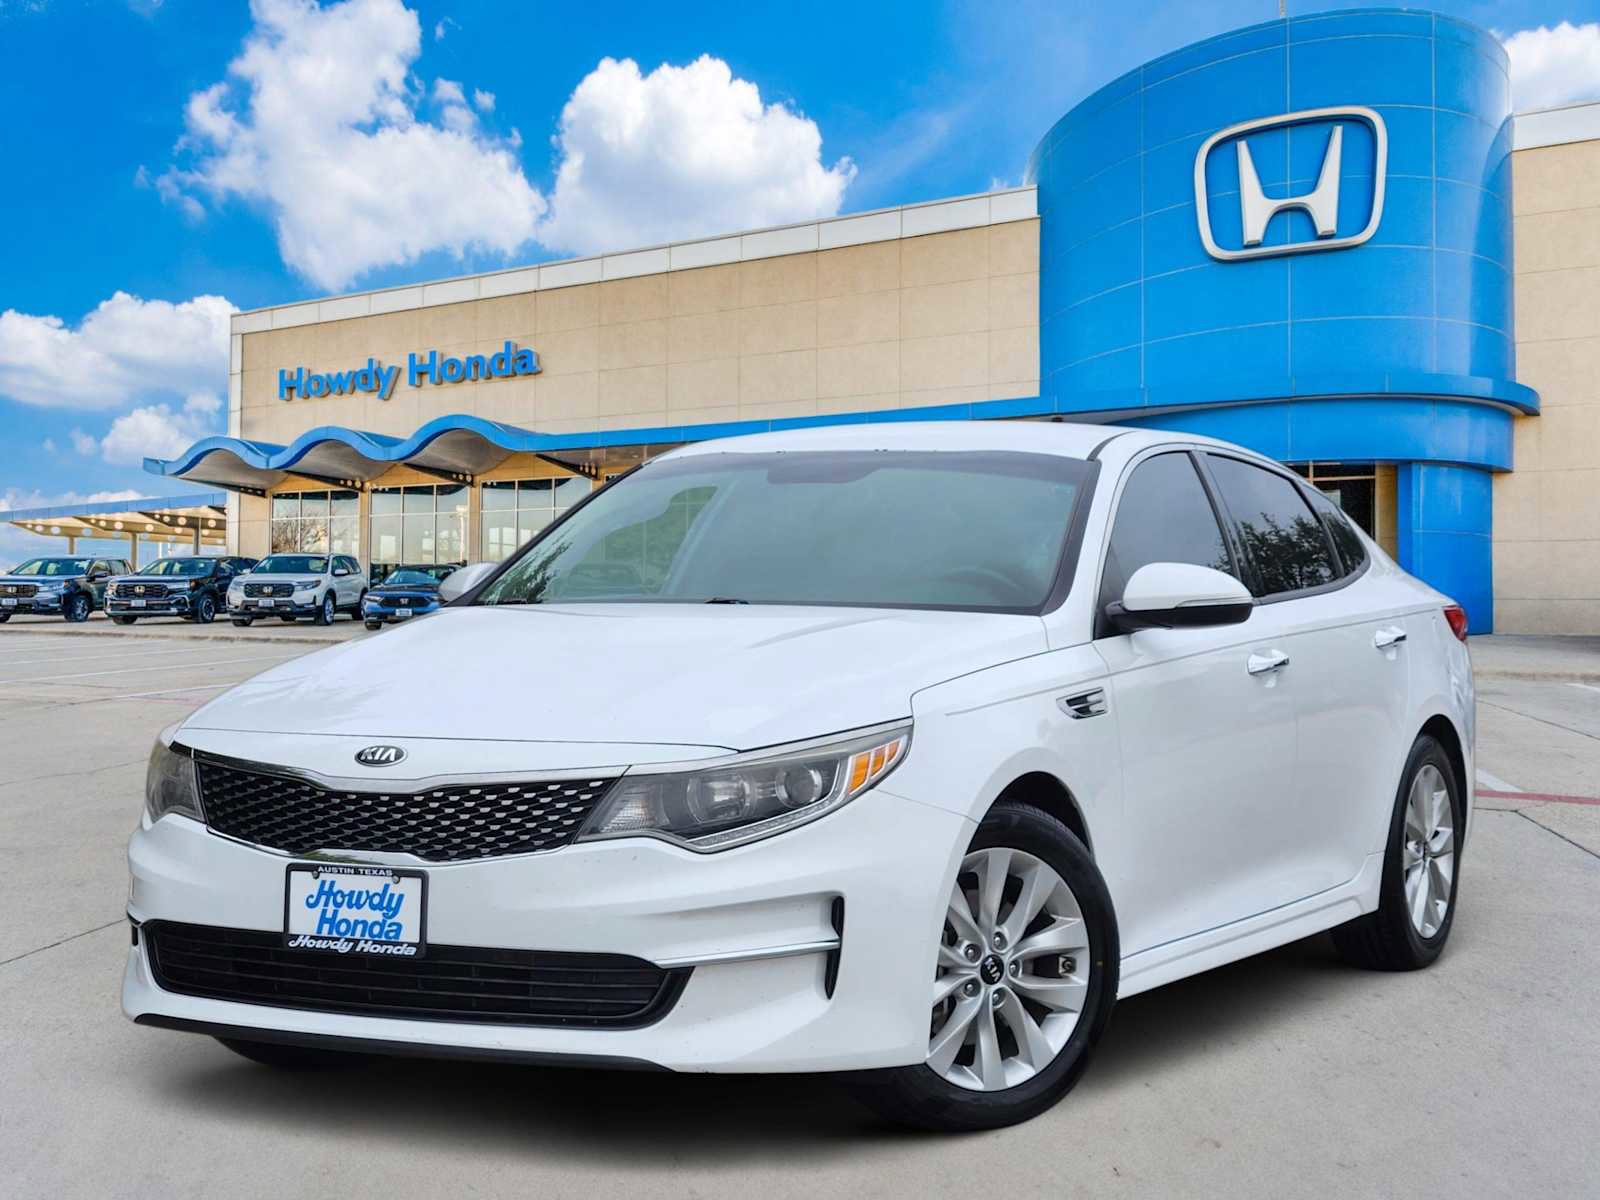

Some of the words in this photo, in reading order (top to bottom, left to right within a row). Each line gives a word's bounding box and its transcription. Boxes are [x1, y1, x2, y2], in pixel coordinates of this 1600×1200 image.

[278, 357, 402, 401] Howdy
[408, 340, 543, 388] Honda
[360, 747, 397, 761] KIA
[318, 866, 354, 875] AUSTIN
[358, 868, 393, 877] TEXAS
[305, 880, 405, 920] Howdy
[315, 909, 404, 940] Honda
[288, 935, 354, 953] Howdy
[355, 940, 417, 956] Honda
